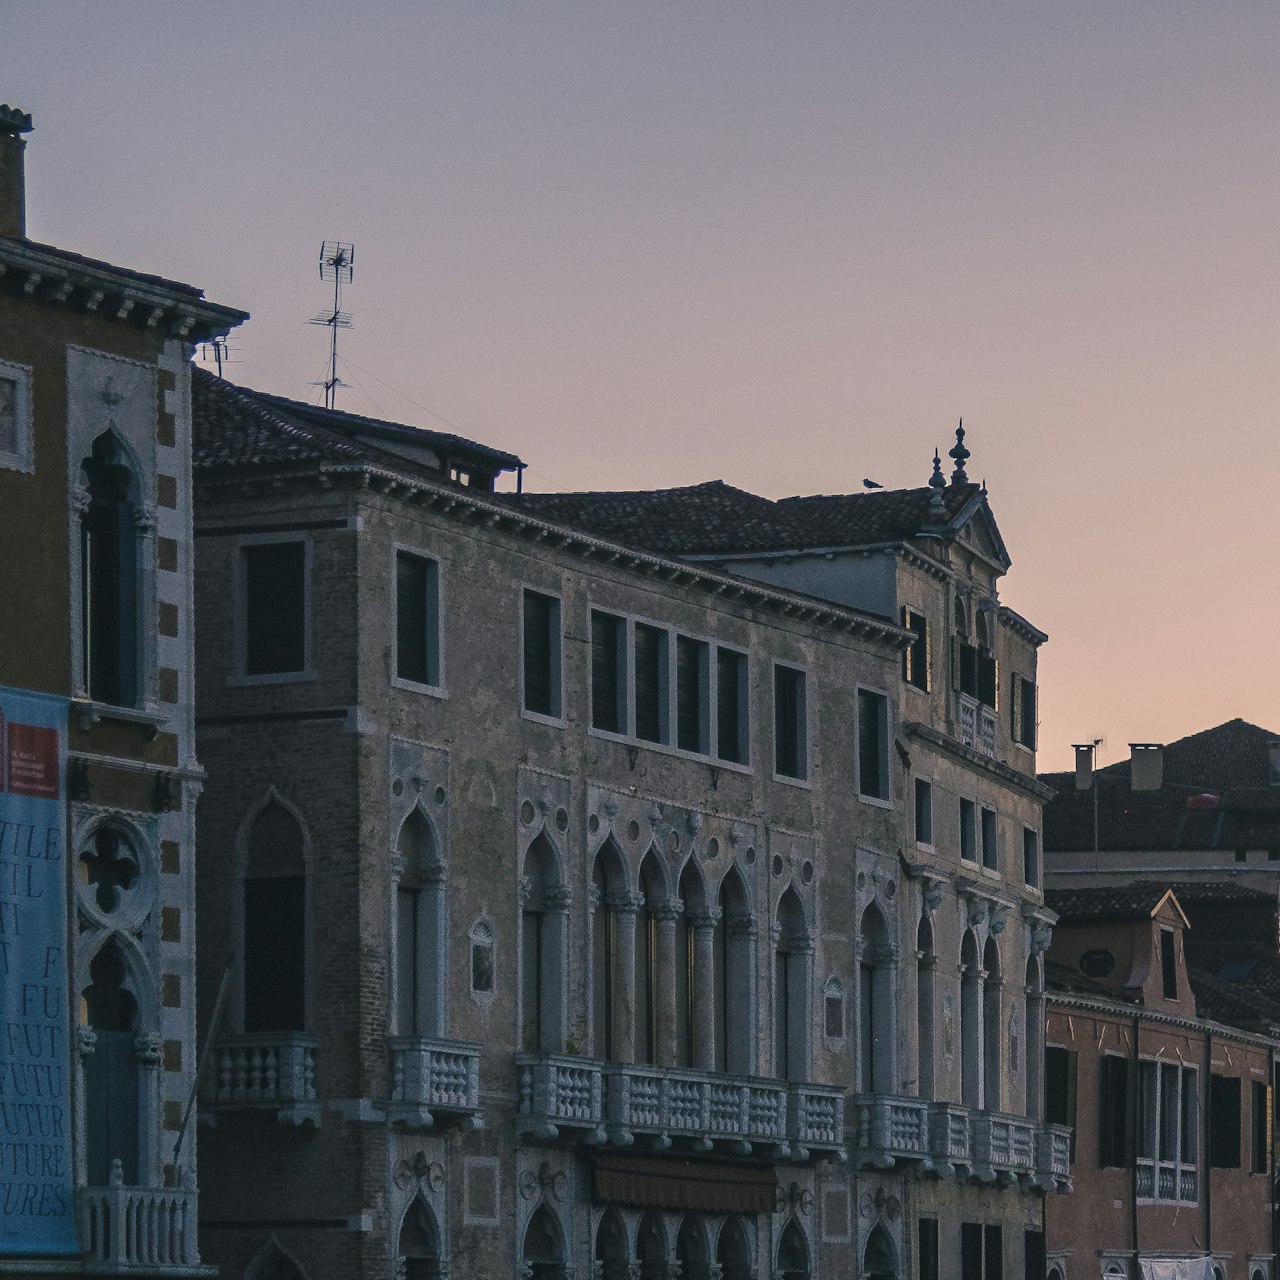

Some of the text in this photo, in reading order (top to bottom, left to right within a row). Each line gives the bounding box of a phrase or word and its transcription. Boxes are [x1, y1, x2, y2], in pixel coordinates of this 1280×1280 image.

[43, 946, 61, 978] F
[22, 984, 61, 1019] FU
[6, 1022, 62, 1058] FUT
